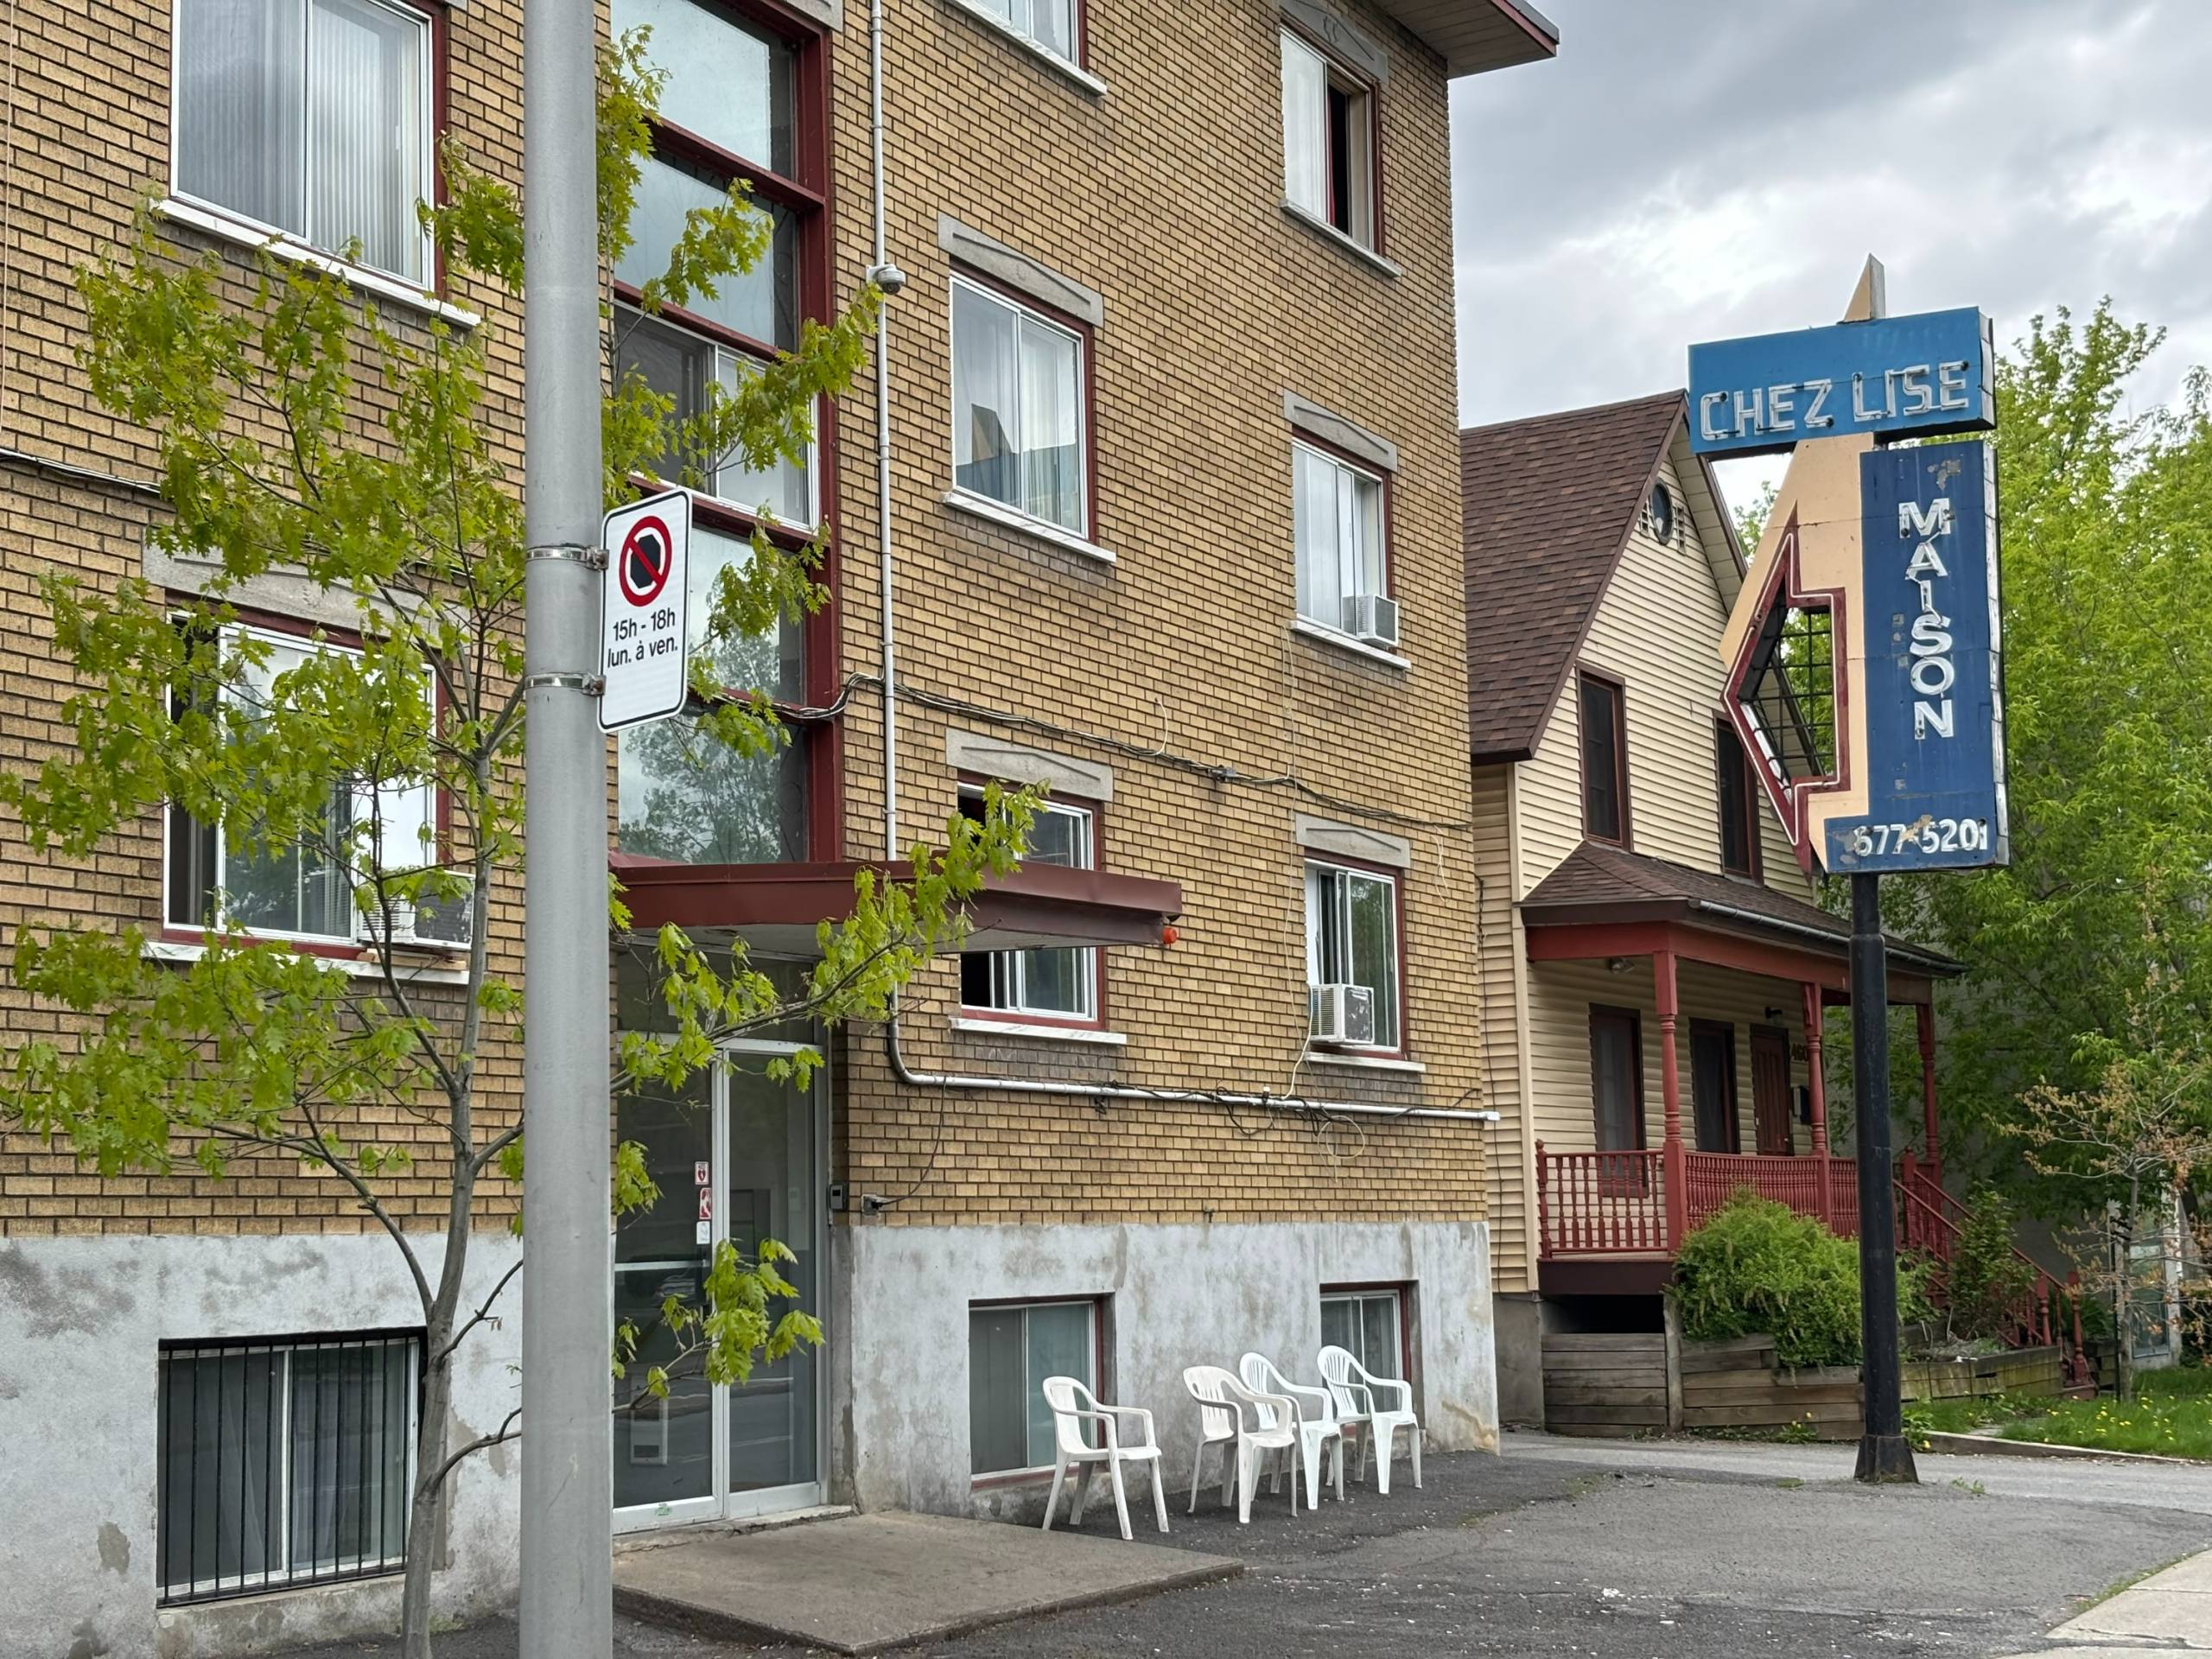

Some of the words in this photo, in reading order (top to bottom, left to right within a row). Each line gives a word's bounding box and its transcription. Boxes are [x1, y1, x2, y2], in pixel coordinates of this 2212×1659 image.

[1700, 378, 1834, 441] CHEZ
[1852, 360, 1969, 423] LISE
[613, 618, 638, 642] 15h
[650, 607, 676, 632] 18h
[1898, 498, 1955, 741] MAISON
[607, 648, 632, 669] lun.
[635, 639, 645, 661] à
[649, 637, 678, 658] ven.
